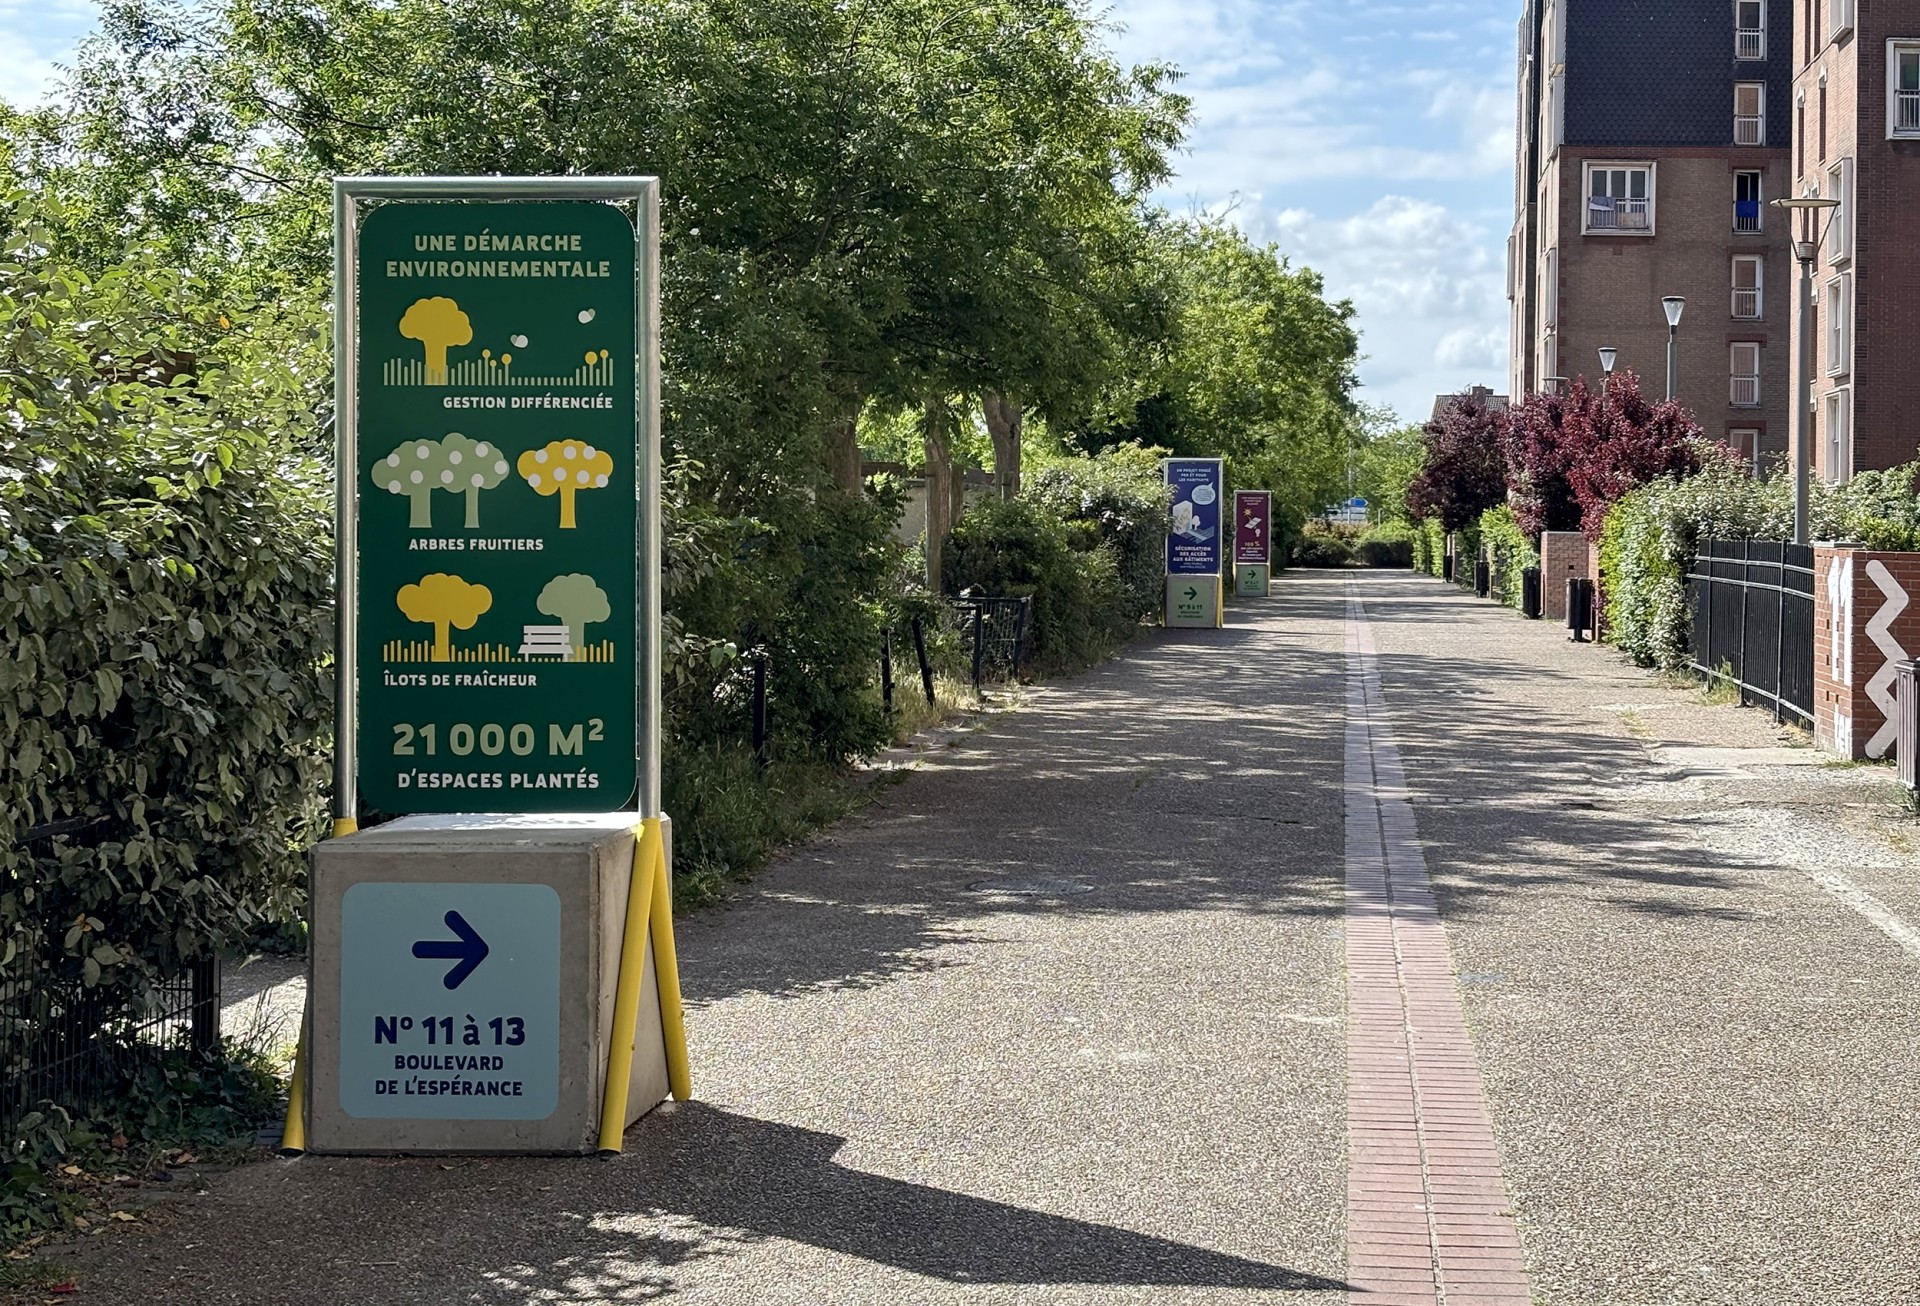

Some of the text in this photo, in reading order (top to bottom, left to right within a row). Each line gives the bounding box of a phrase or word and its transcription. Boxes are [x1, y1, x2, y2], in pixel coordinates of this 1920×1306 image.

[414, 228, 582, 251] UNE DÉMARCHE
[386, 261, 610, 277] ENVIRONNEMENTALE
[443, 392, 613, 409] GESTION DIFFÉRENCIÉE
[408, 538, 544, 551] ARBRES FRUITIERS
[384, 669, 537, 686] ÎLOTS DE FRAÎCHEUR
[393, 723, 436, 756] 21
[449, 723, 535, 756] 000
[398, 767, 599, 788] D'ESPACES PLANTÉS
[421, 1016, 454, 1045] 11
[462, 1014, 480, 1046] à
[488, 1016, 526, 1047] 13
[394, 1055, 504, 1071] BOULEVARD
[375, 1074, 523, 1096] DE L'ESPÉRANCE
